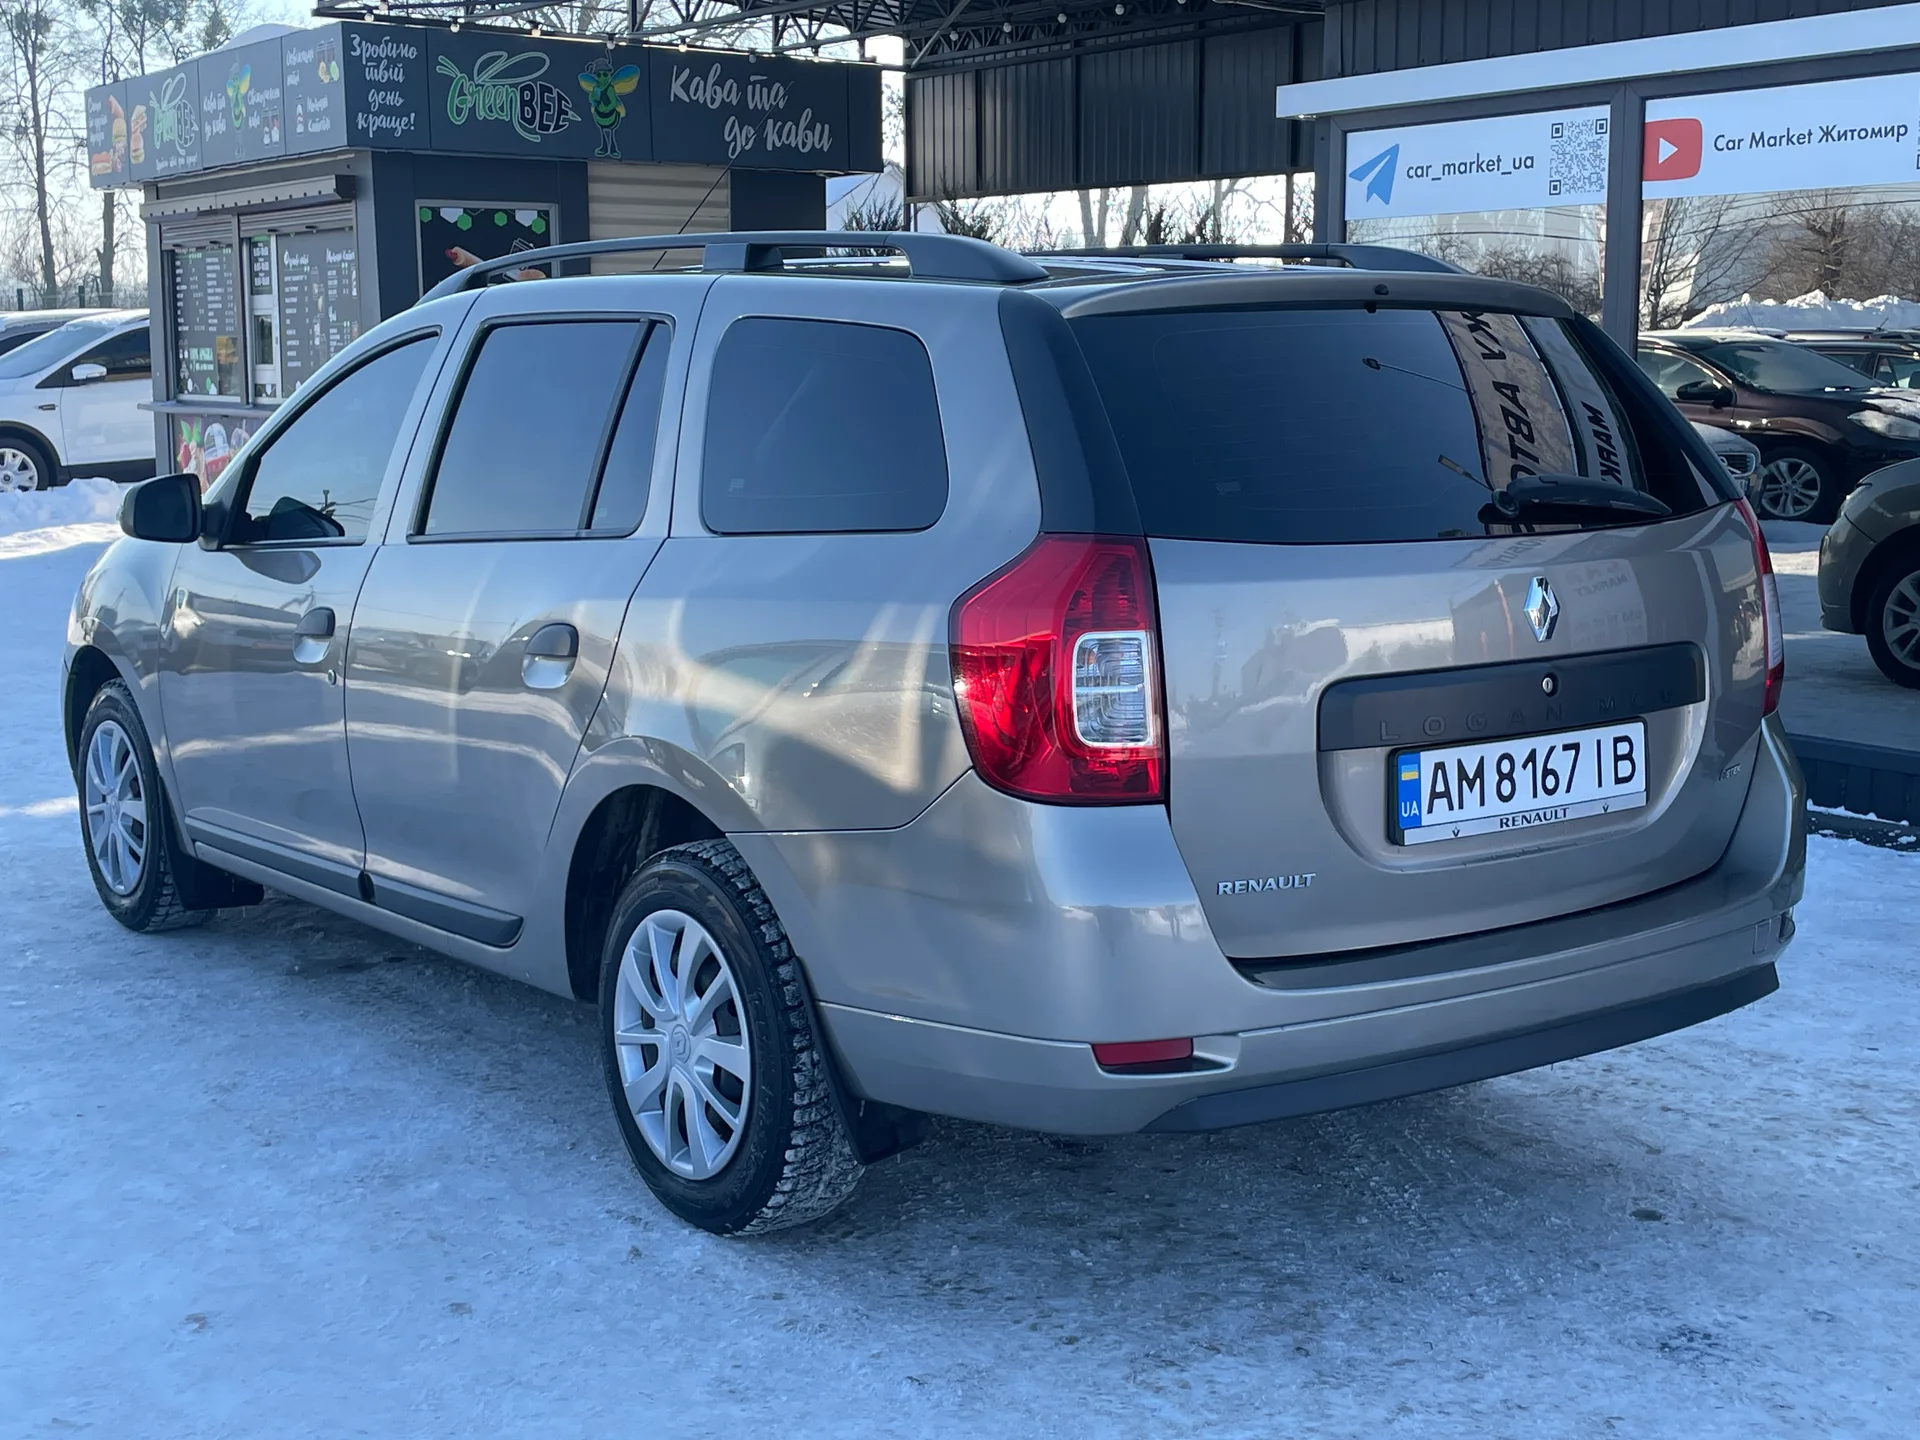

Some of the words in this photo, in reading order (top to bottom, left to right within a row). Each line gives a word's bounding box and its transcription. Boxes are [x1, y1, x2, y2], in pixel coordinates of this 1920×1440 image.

[350, 34, 418, 65] Зробимо
[365, 59, 405, 83] твій
[368, 88, 404, 112] день
[670, 62, 742, 110] Кава
[747, 75, 788, 111] та
[356, 112, 416, 138] краще!
[724, 115, 757, 159] до
[763, 107, 833, 153] кави
[1713, 134, 1744, 152] Car
[1749, 127, 1813, 149] Market
[1817, 123, 1909, 143] Житомир
[1406, 152, 1535, 181] car_market_ua
[1380, 703, 1564, 741] LOGAN
[1401, 800, 1420, 818] UA
[1499, 807, 1570, 829] RENAULT
[1217, 873, 1317, 896] RENAULT
